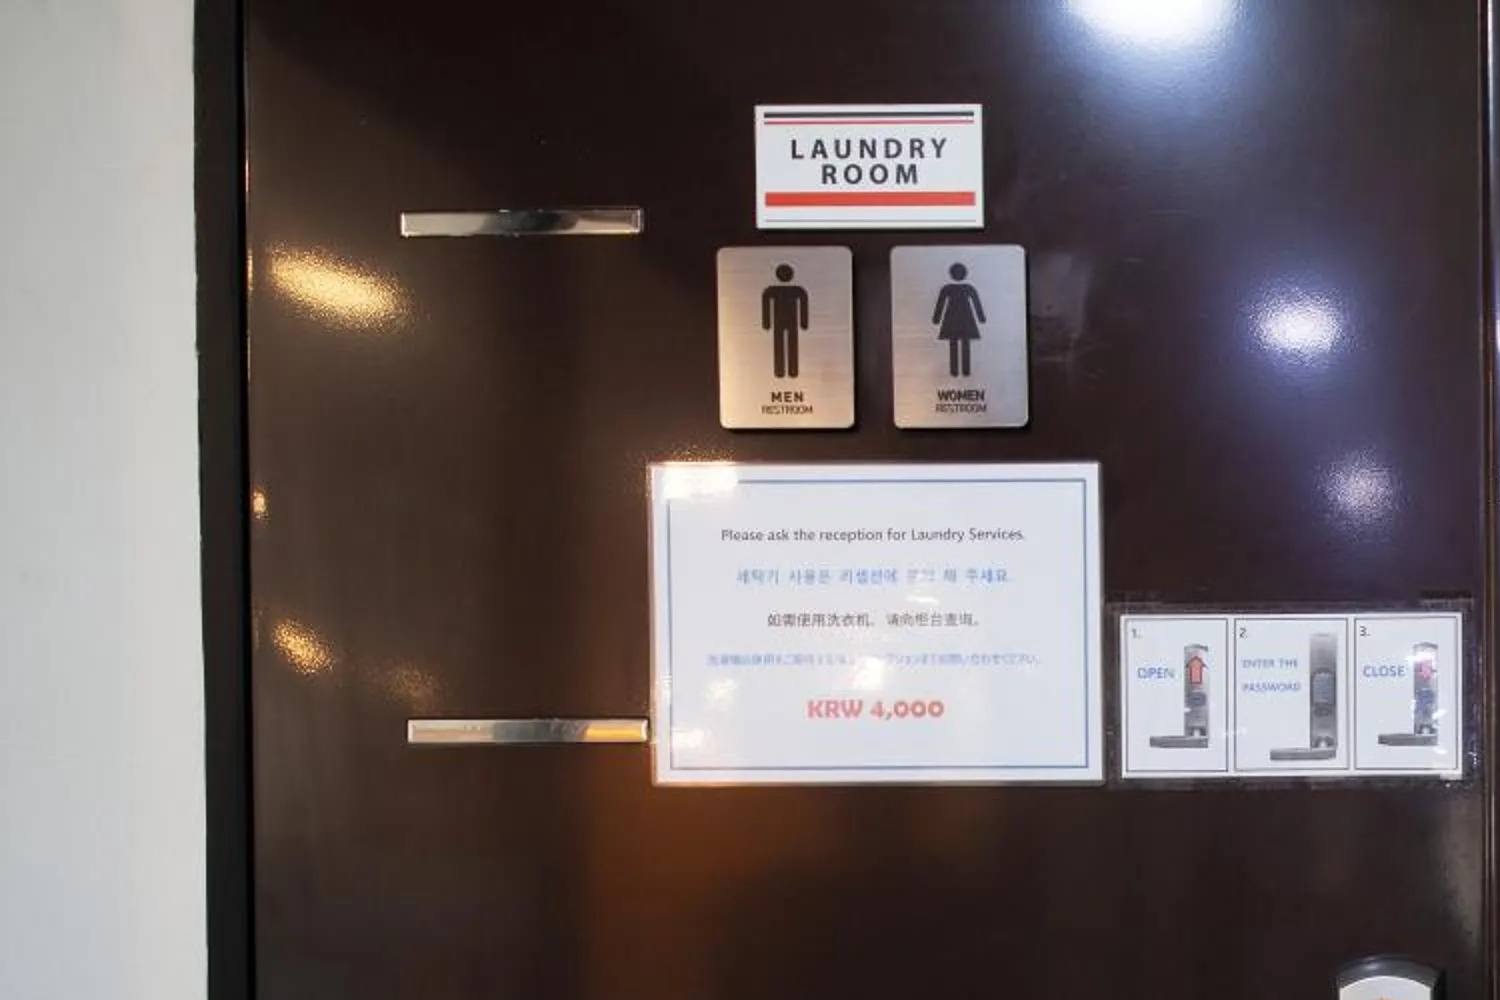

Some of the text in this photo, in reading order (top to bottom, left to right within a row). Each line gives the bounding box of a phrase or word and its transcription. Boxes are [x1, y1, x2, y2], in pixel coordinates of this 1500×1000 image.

[790, 138, 949, 160] LAUNDRY
[821, 163, 919, 185] ROOM
[771, 391, 804, 403] MEN
[937, 389, 986, 402] WOMEN
[761, 404, 813, 415] RESTROOM
[935, 403, 987, 414] RESTROOM
[721, 527, 1026, 544] Please ask the reception for Laundry Services.
[737, 568, 779, 584] 세탁기
[789, 568, 831, 585] 사용은
[1360, 626, 1371, 637] 3.
[1242, 659, 1298, 669] ENTER THE
[1137, 667, 1175, 679] OPEN
[1363, 665, 1406, 678] CLOSE
[1242, 681, 1301, 692] PASSWORD
[806, 700, 945, 720] KRW 4,000
